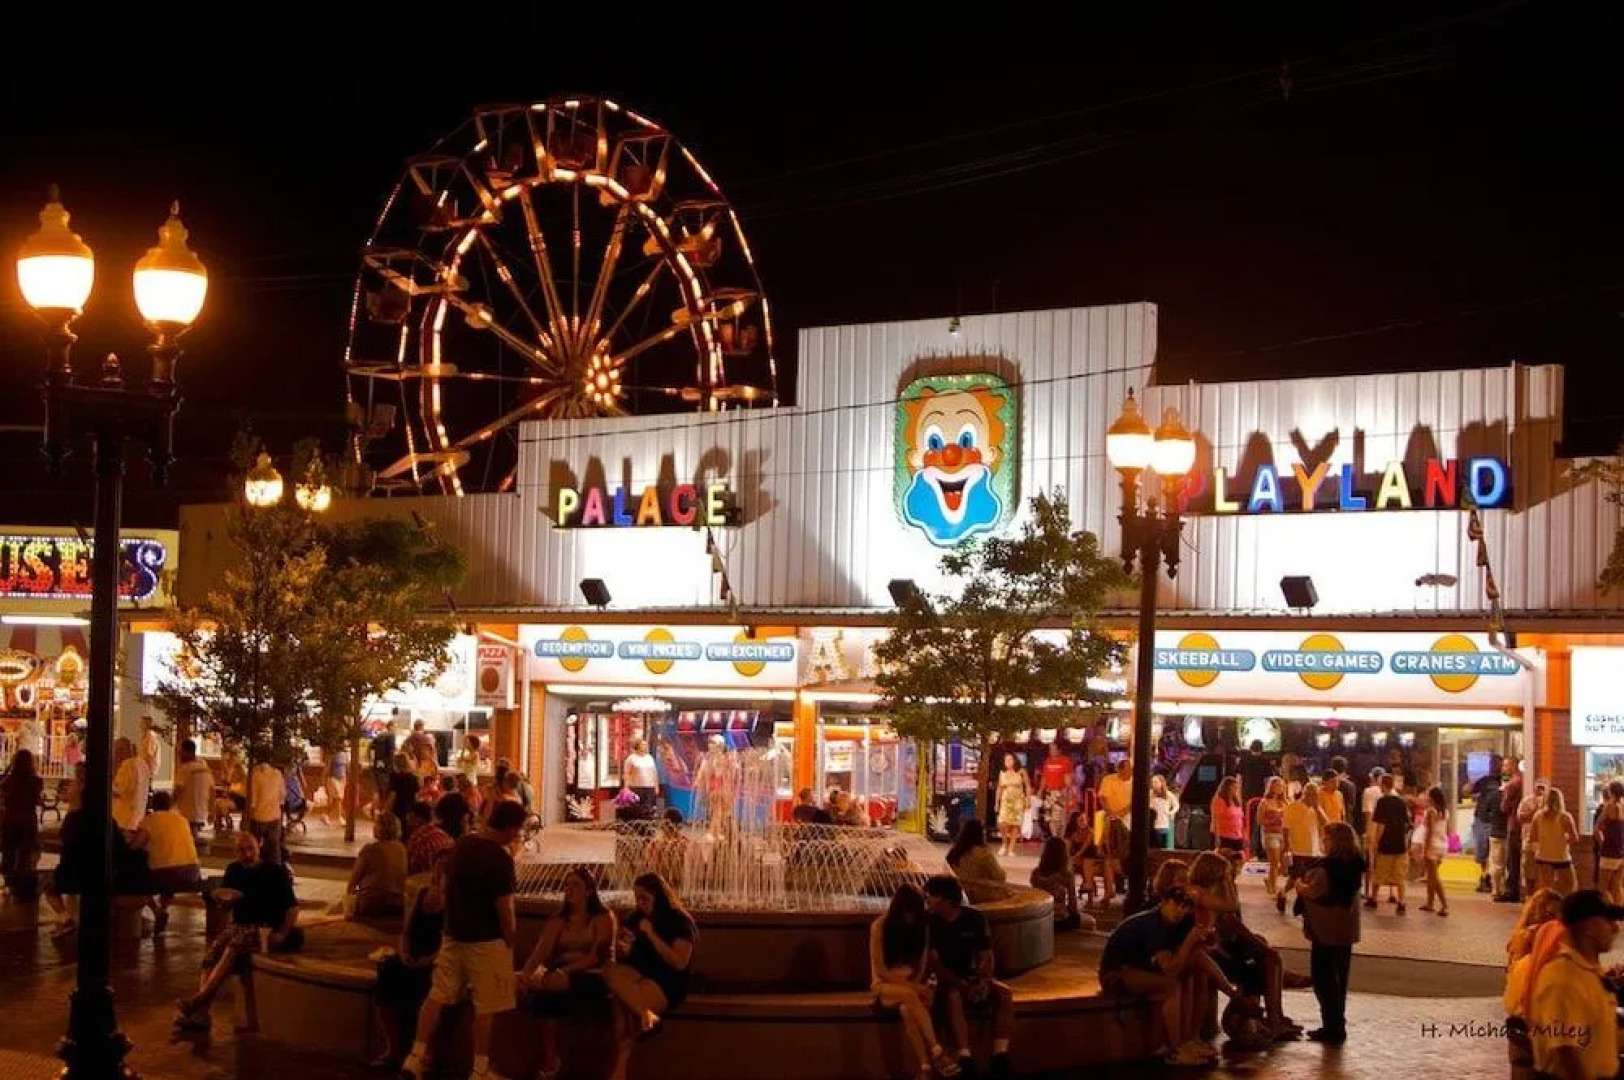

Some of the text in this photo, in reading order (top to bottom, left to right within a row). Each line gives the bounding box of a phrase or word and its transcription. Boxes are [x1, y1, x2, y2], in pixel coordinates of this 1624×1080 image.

[1178, 457, 1509, 513] PLAYLAND
[557, 484, 727, 526] PALACE
[478, 648, 507, 658] PIZZA
[541, 642, 607, 653] REDEMPTION
[1158, 652, 1240, 666] SKEEBALL
[1267, 654, 1381, 669] VIDEO GAMES
[1395, 656, 1515, 670] CRANES ATM
